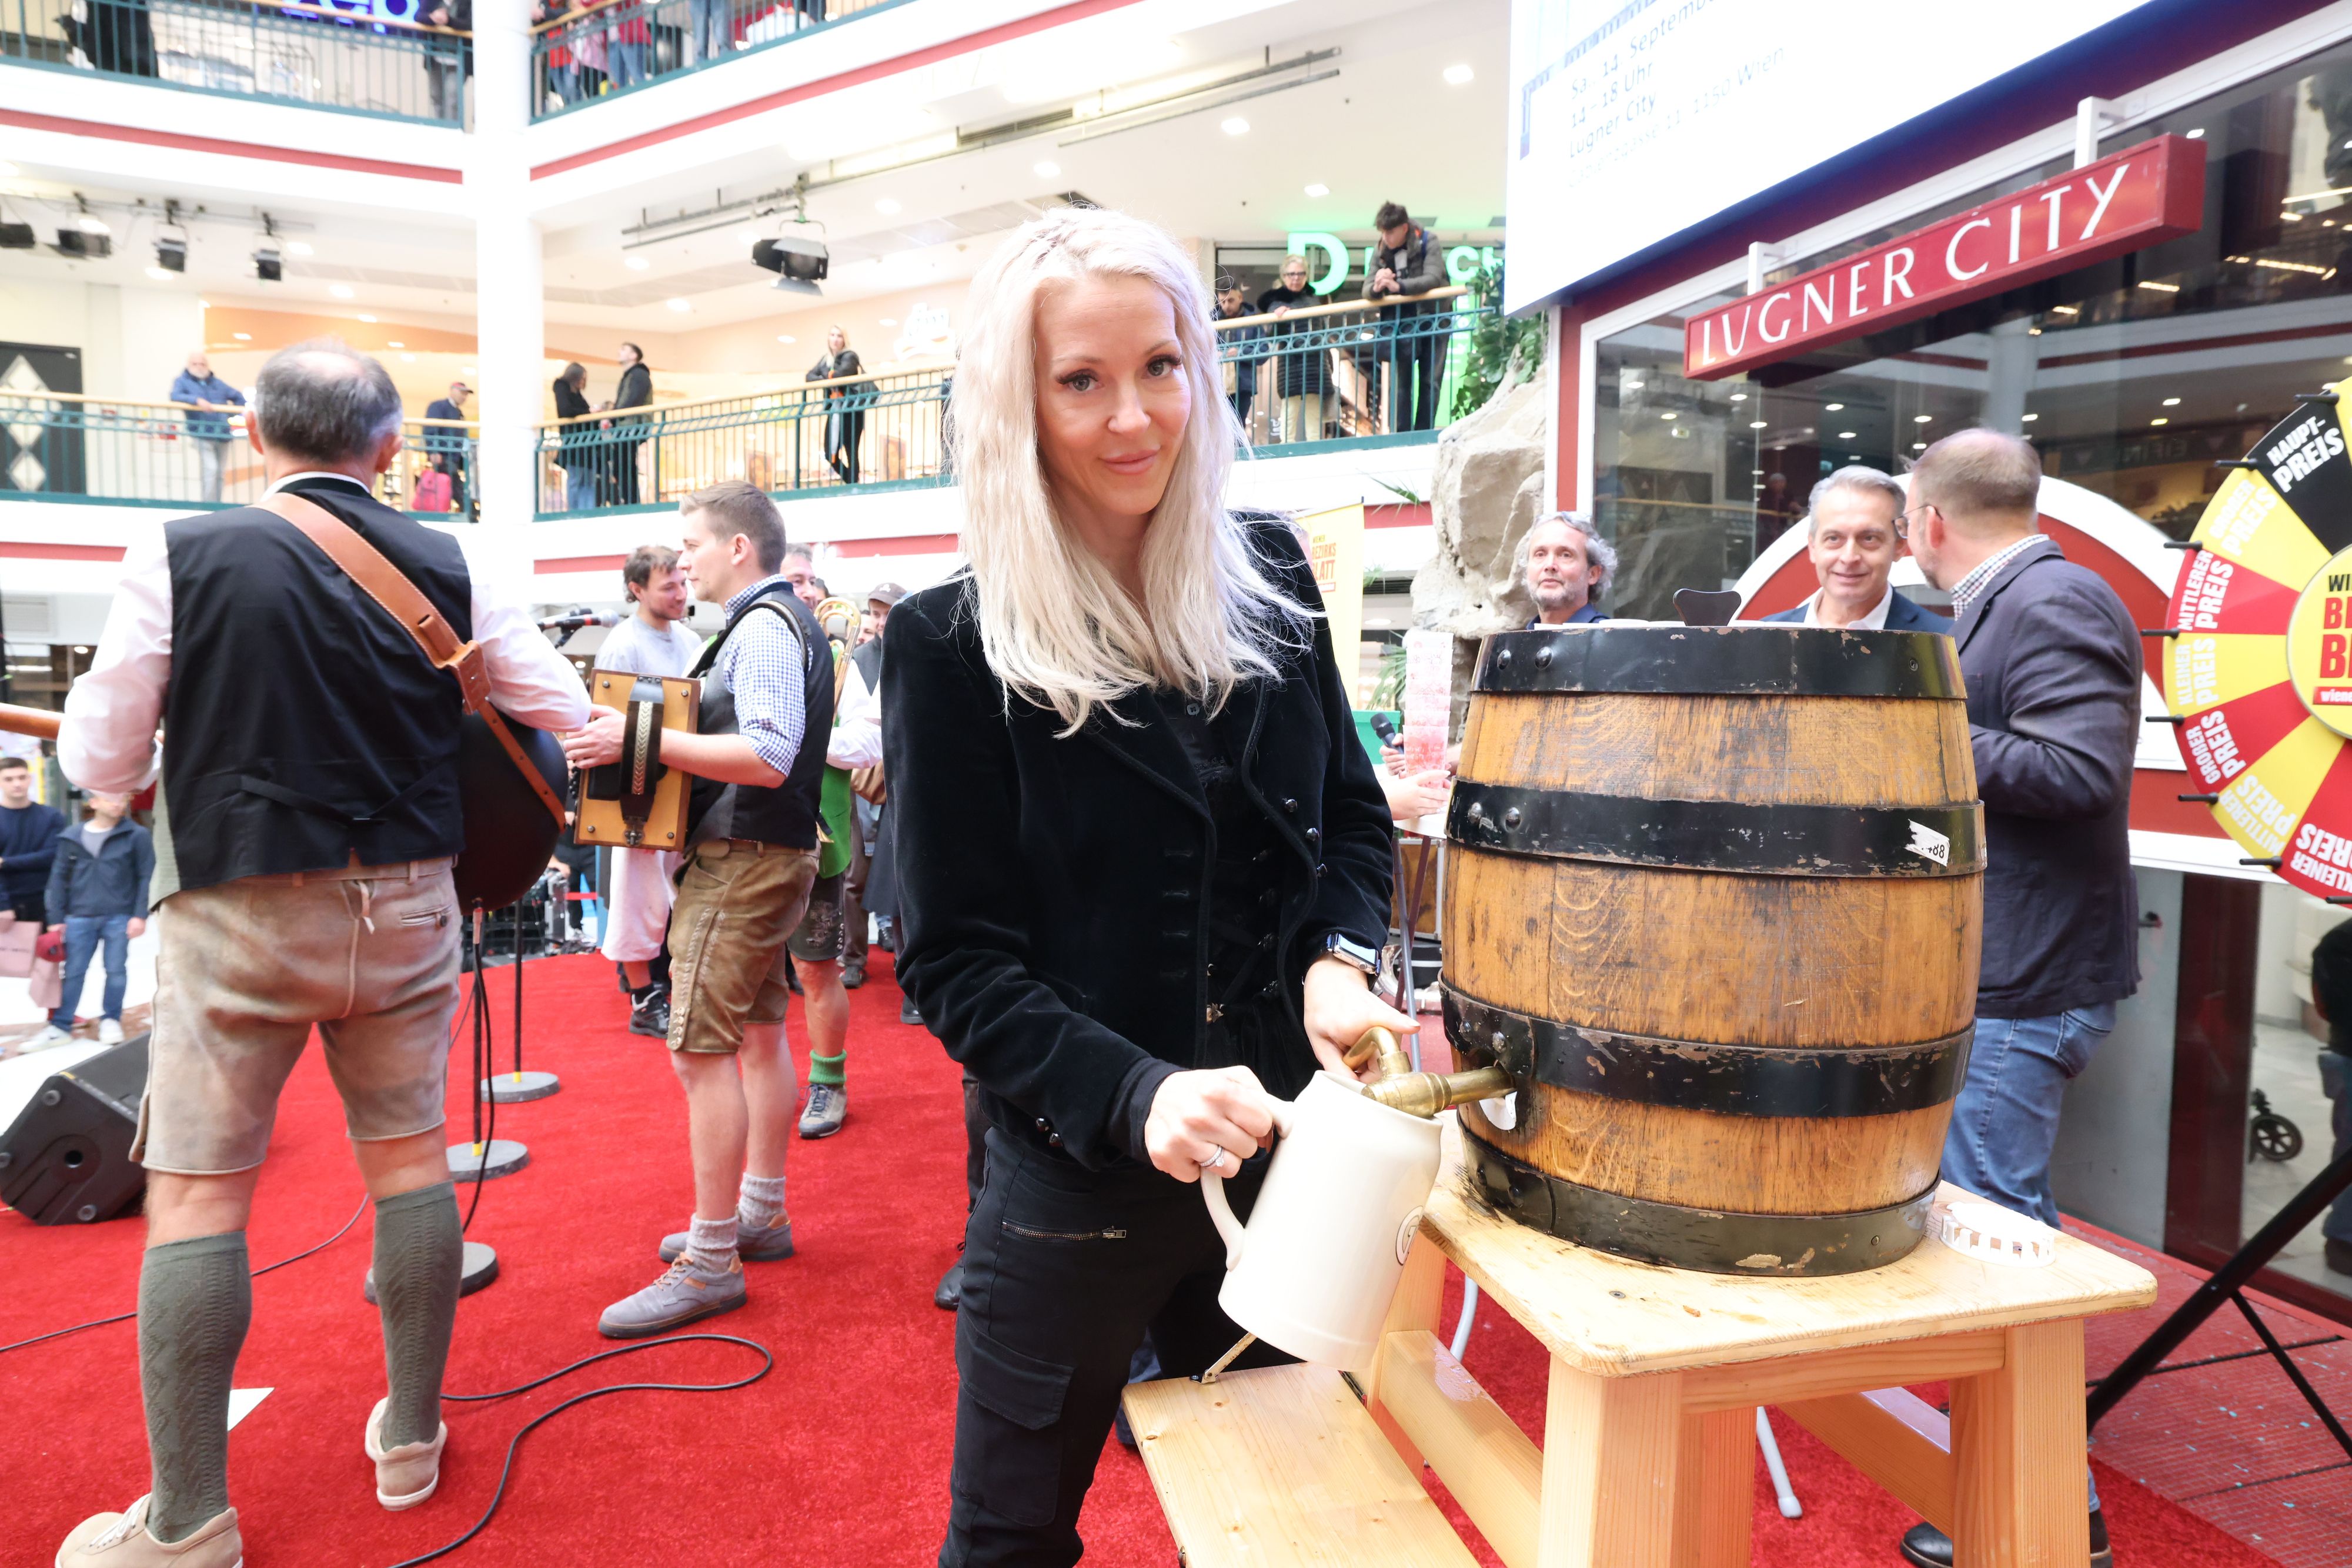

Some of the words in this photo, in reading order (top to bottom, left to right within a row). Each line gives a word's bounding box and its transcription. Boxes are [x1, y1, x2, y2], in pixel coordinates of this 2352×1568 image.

[1630, 0, 1715, 58] Septemb
[1625, 62, 1653, 92] Uhr
[1737, 46, 1783, 86] Wien
[1570, 115, 1620, 158] Lugner
[1626, 91, 1656, 121] City
[1701, 247, 1915, 366] LUGNER
[1945, 164, 2130, 281] CITY
[2266, 416, 2326, 467] HAUPT-
[2272, 427, 2344, 493] PREIS
[2221, 487, 2277, 556] PREIS
[2177, 550, 2214, 631] MITTLERER
[2194, 560, 2234, 629] PREIS
[2175, 644, 2193, 706] KLEINER
[2192, 638, 2219, 706] PREIS
[2200, 710, 2246, 779] PREIS
[2219, 790, 2286, 856] MITTLERER
[2236, 775, 2297, 837] PREIS
[2296, 823, 2352, 870] REIS
